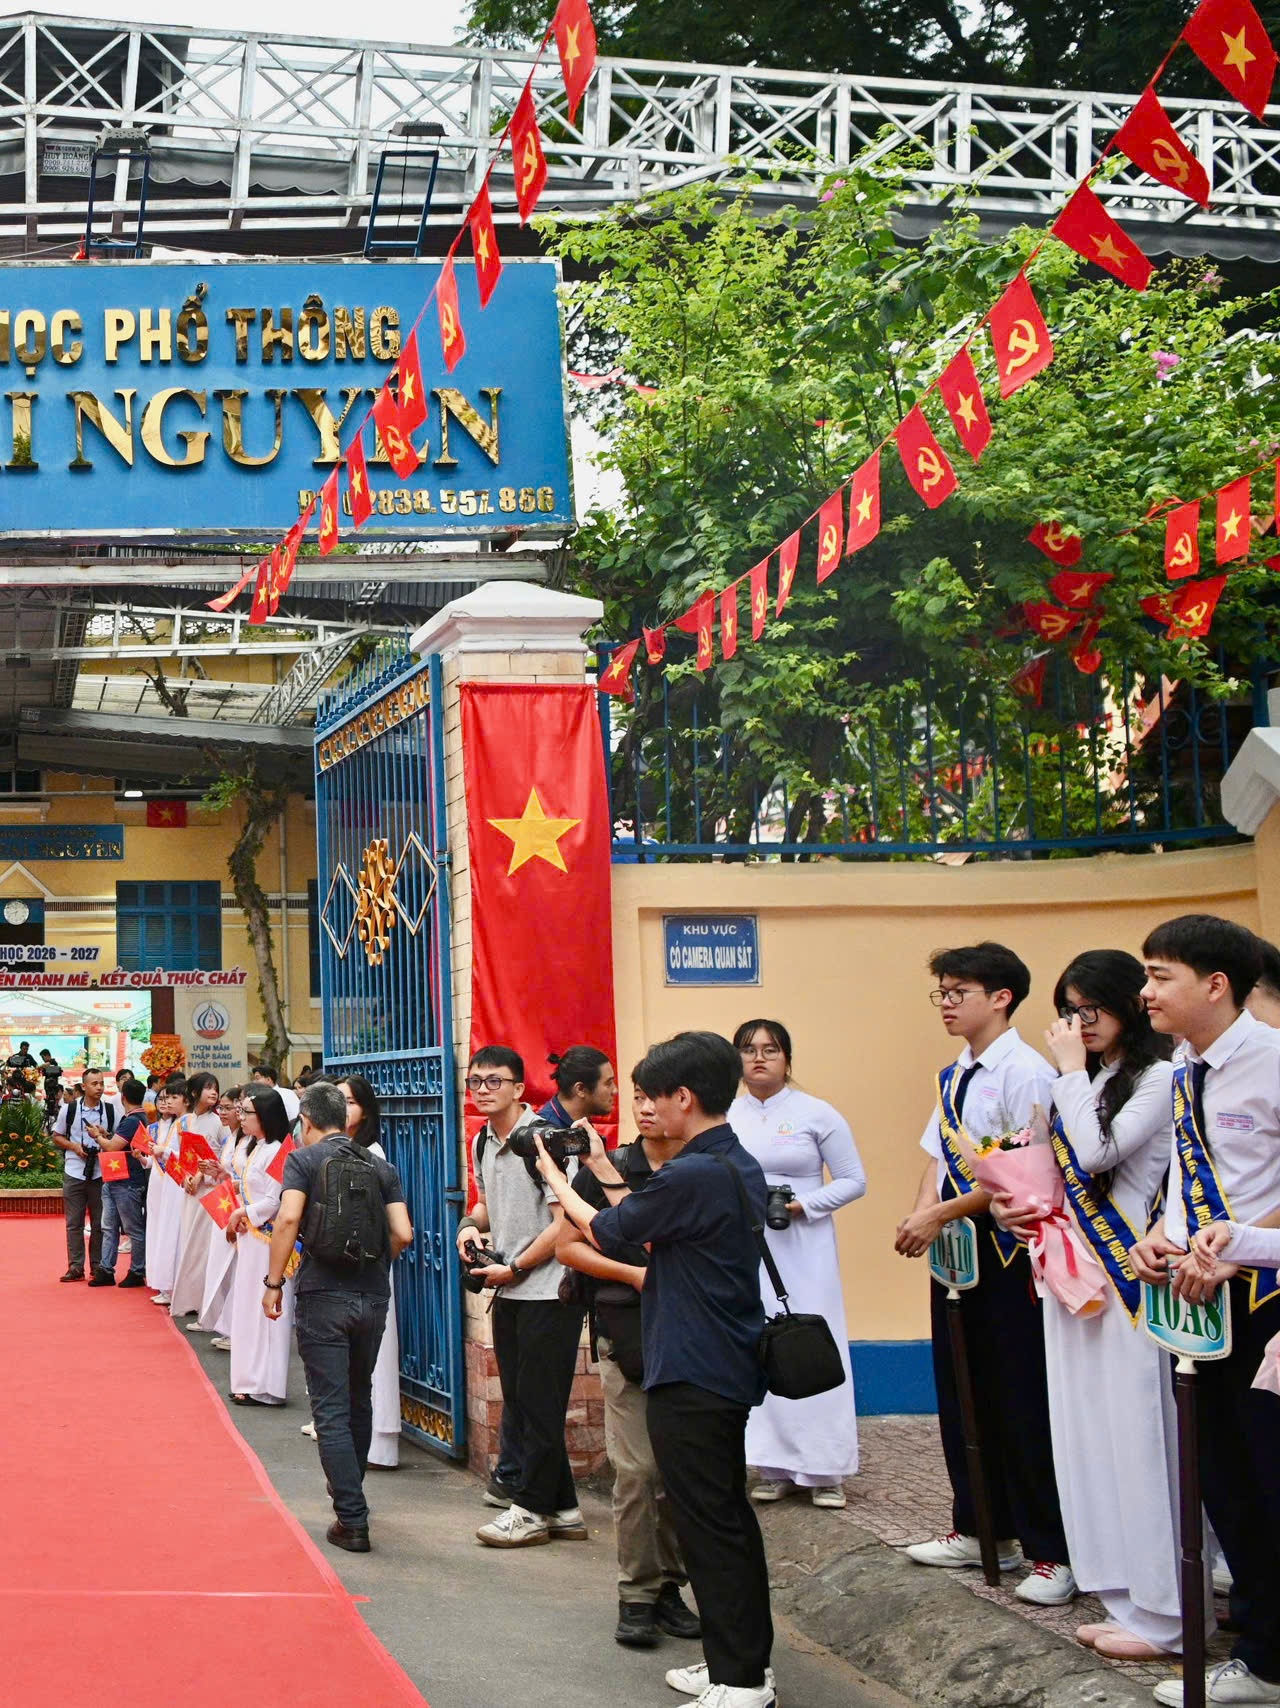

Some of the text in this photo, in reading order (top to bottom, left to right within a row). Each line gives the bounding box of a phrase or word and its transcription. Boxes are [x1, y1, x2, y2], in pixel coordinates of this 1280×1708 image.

[226, 293, 401, 362] THÔNG
[498, 486, 555, 514] 866
[683, 923, 738, 937] KHU VỰC
[0, 946, 24, 964] HỌC
[26, 946, 57, 961] 2026
[70, 946, 100, 961] 2027
[669, 939, 753, 970] CÓ CAMERA QUAN SÁT
[18, 973, 64, 991] MẠNH
[66, 970, 90, 986] MẼ
[100, 967, 129, 985] KẾT
[130, 967, 163, 986] QUẢ
[167, 971, 206, 989] THỰC
[208, 966, 248, 985] CHẤT
[1090, 1215, 1116, 1243] KHAI
[930, 1230, 973, 1275] 10A10
[1149, 1280, 1223, 1341] 10A8
